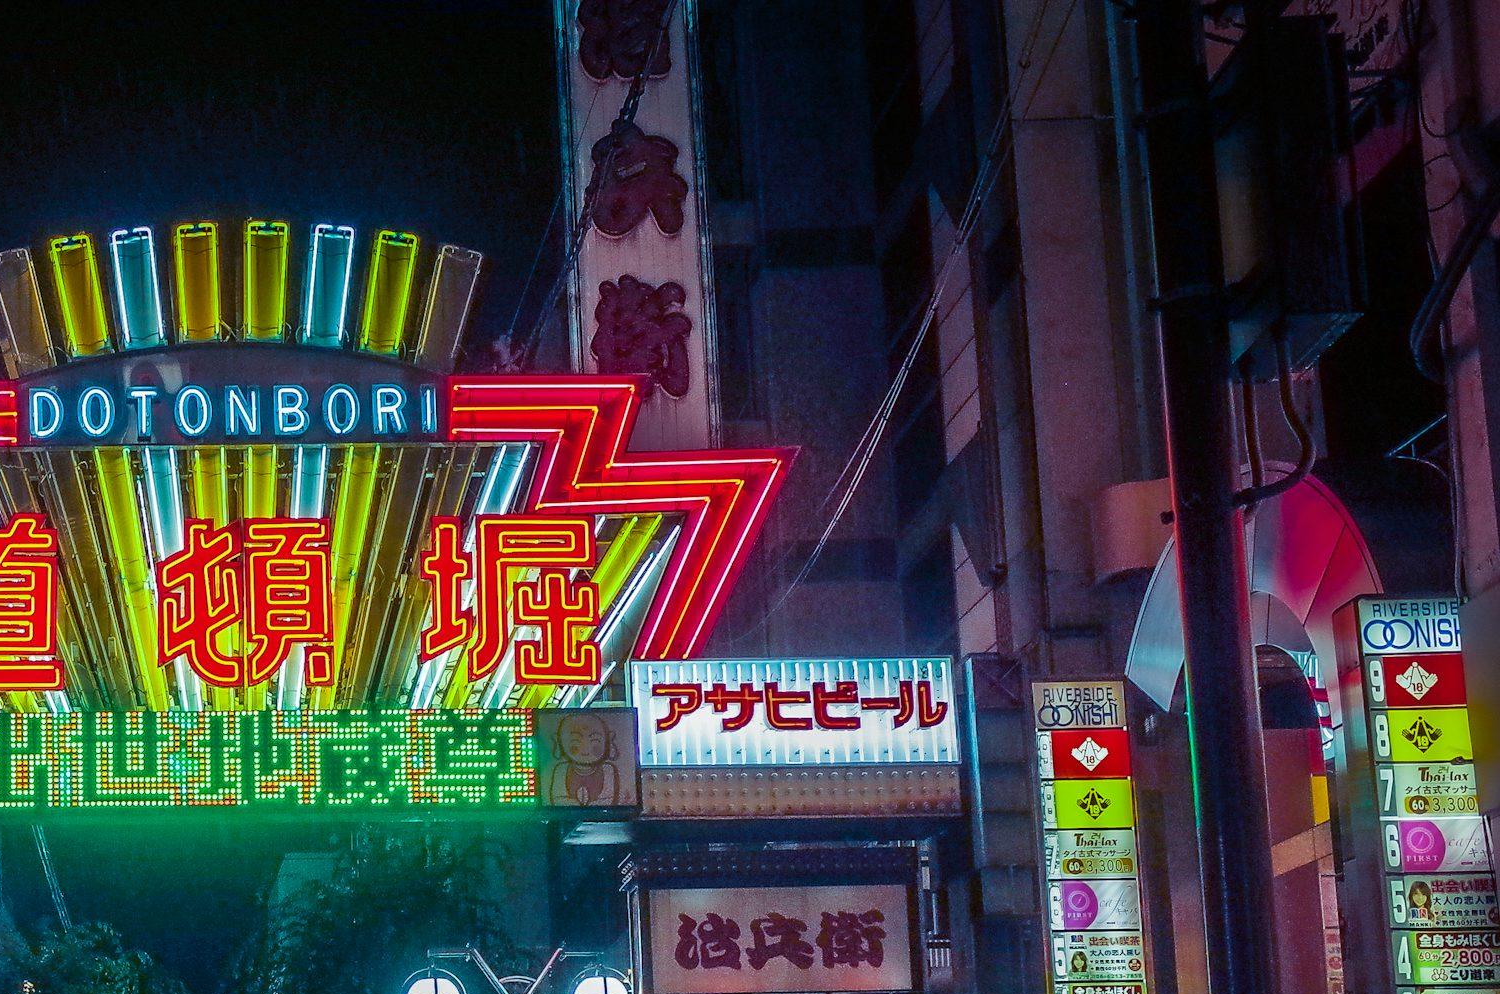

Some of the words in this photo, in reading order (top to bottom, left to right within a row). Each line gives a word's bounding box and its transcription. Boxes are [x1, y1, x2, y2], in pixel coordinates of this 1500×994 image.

[29, 384, 437, 438] DOTONBORI
[1372, 602, 1458, 617] RIVERSIDE
[1043, 687, 1114, 701] RIVERSIDE
[1369, 660, 1384, 701] 9
[652, 680, 947, 732] アサヒビール
[1375, 715, 1390, 757] 8
[1380, 769, 1393, 811] 7
[1386, 824, 1400, 867] 6
[1406, 854, 1438, 862] FIRST
[1391, 881, 1406, 923] 5
[1054, 937, 1066, 976] 5
[1398, 936, 1411, 979] 4
[1419, 934, 1500, 947] 全身もみほぐし
